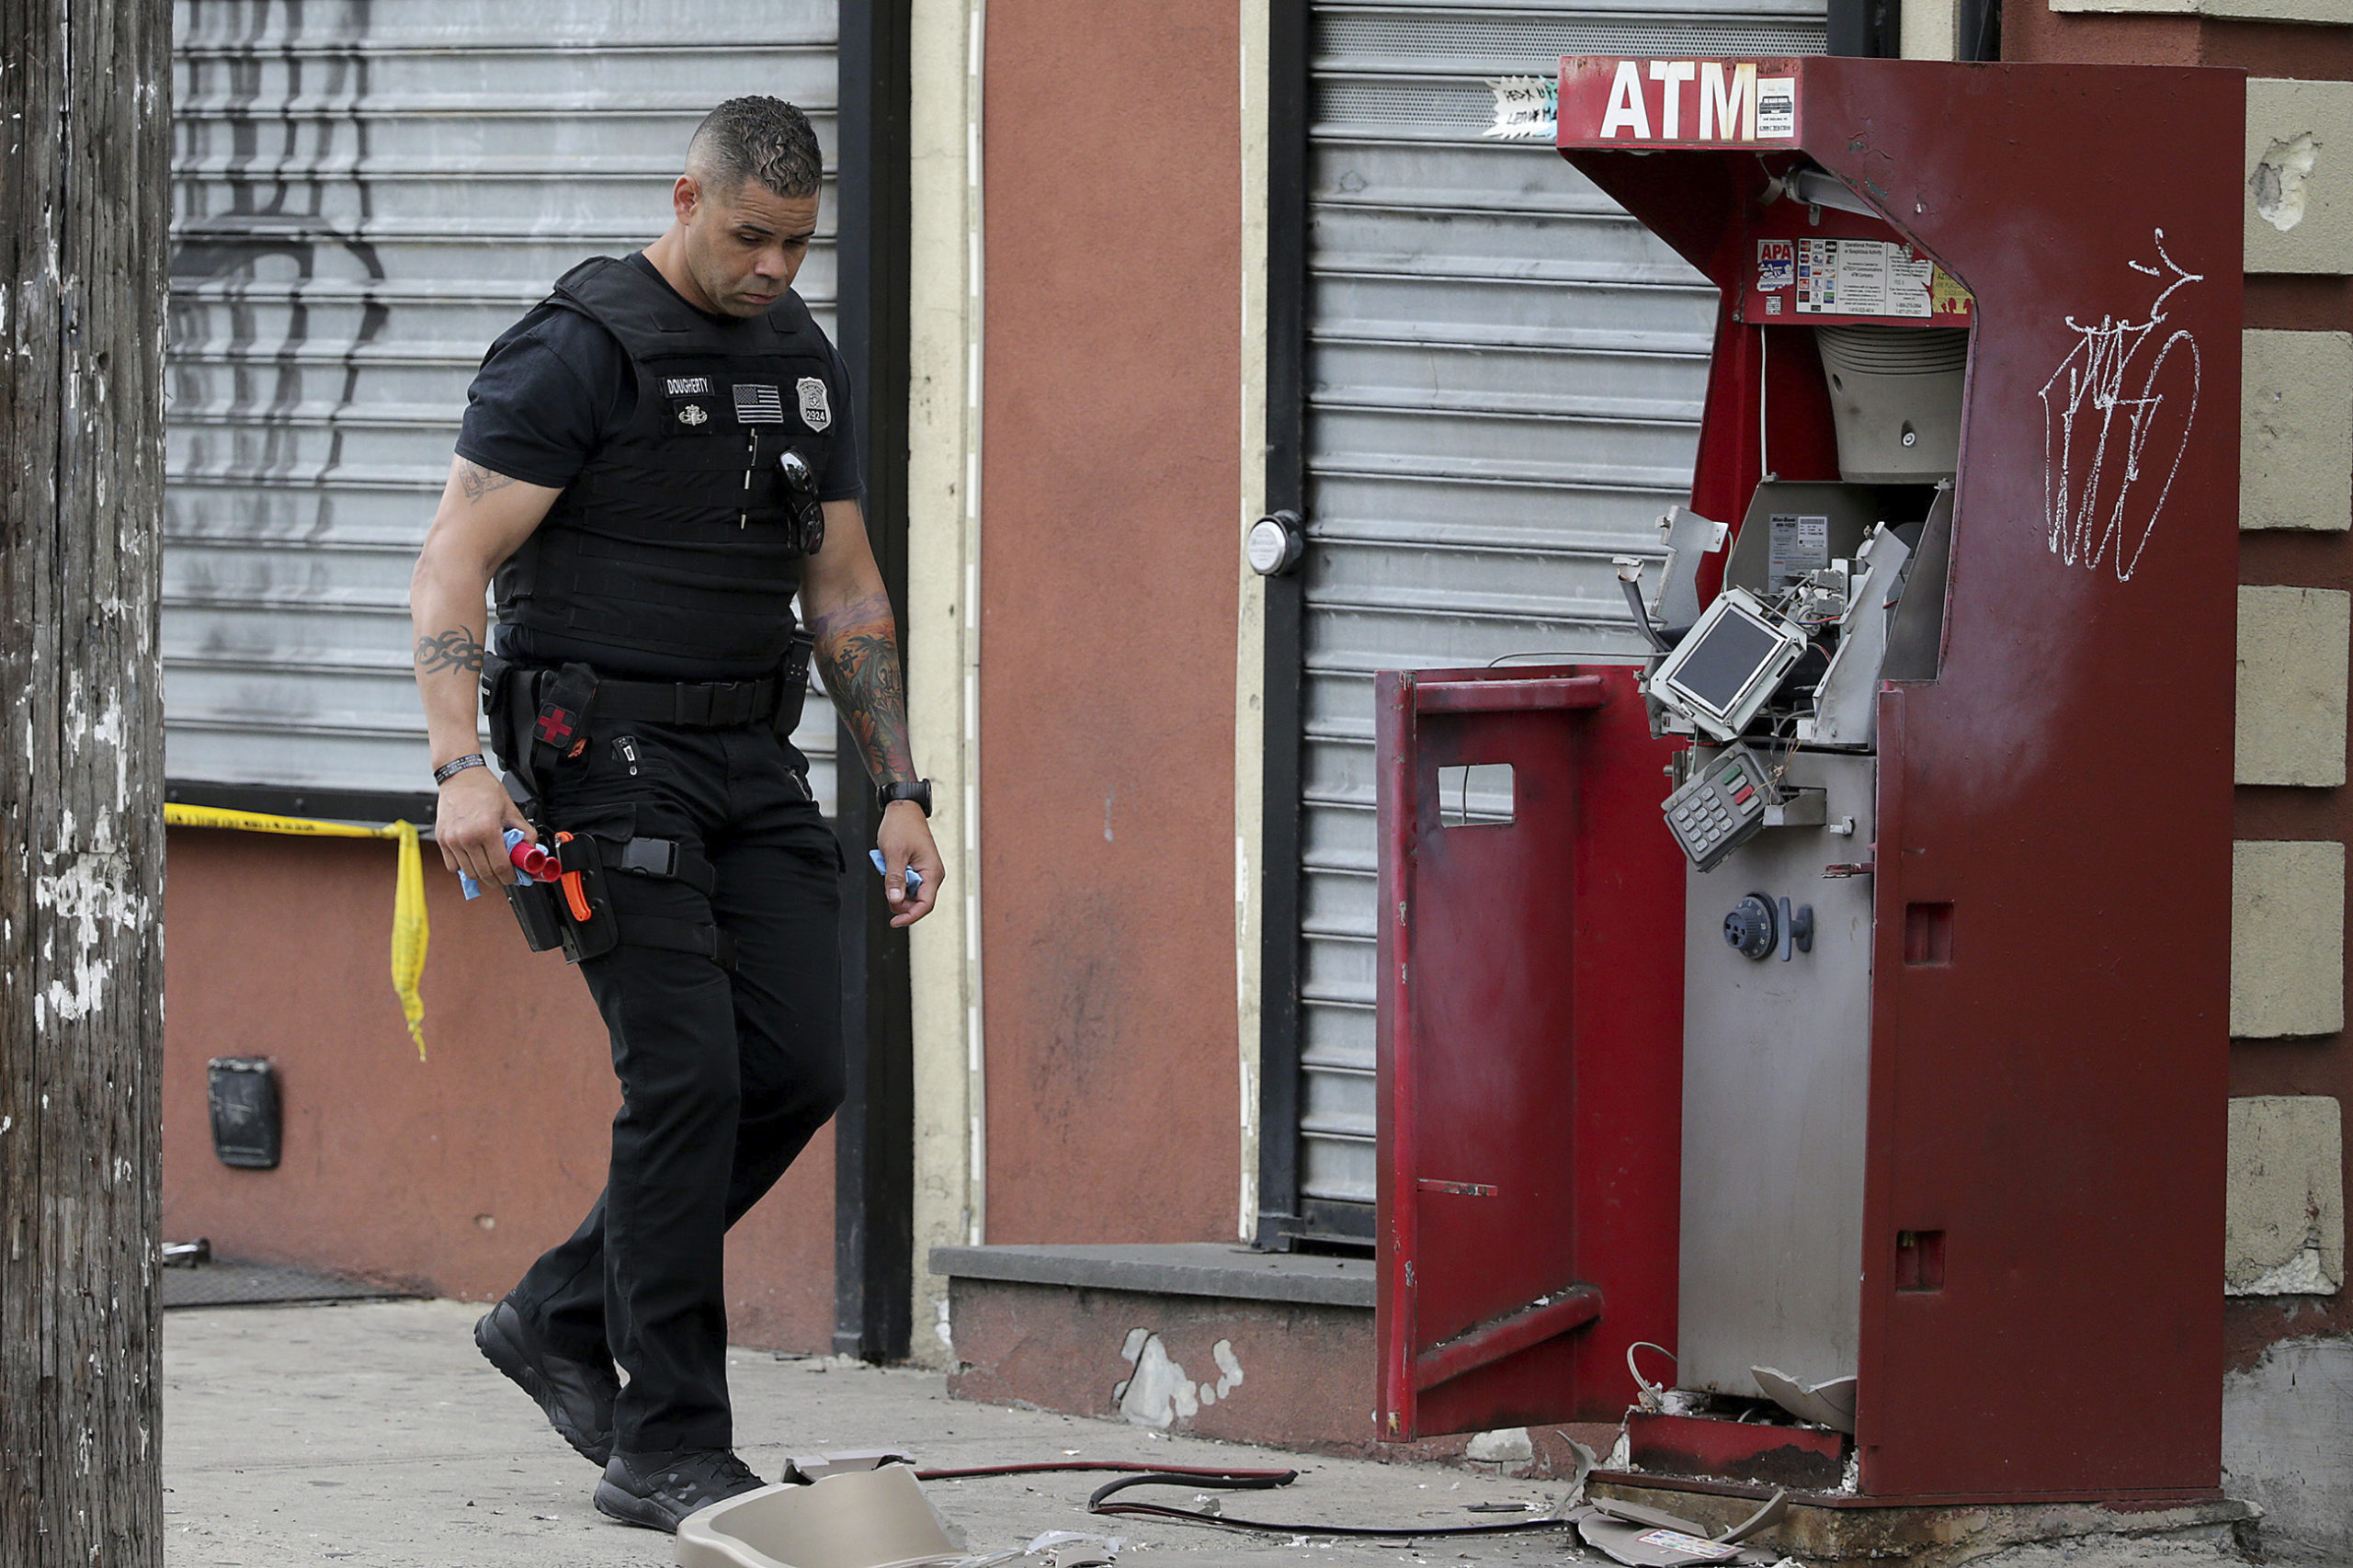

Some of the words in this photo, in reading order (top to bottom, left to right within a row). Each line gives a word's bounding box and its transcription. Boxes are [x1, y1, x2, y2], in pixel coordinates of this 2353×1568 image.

[1599, 60, 1756, 141] ATM
[1761, 244, 1792, 259] APA
[666, 378, 708, 394] DOUGHERTY
[806, 410, 826, 422] 2924
